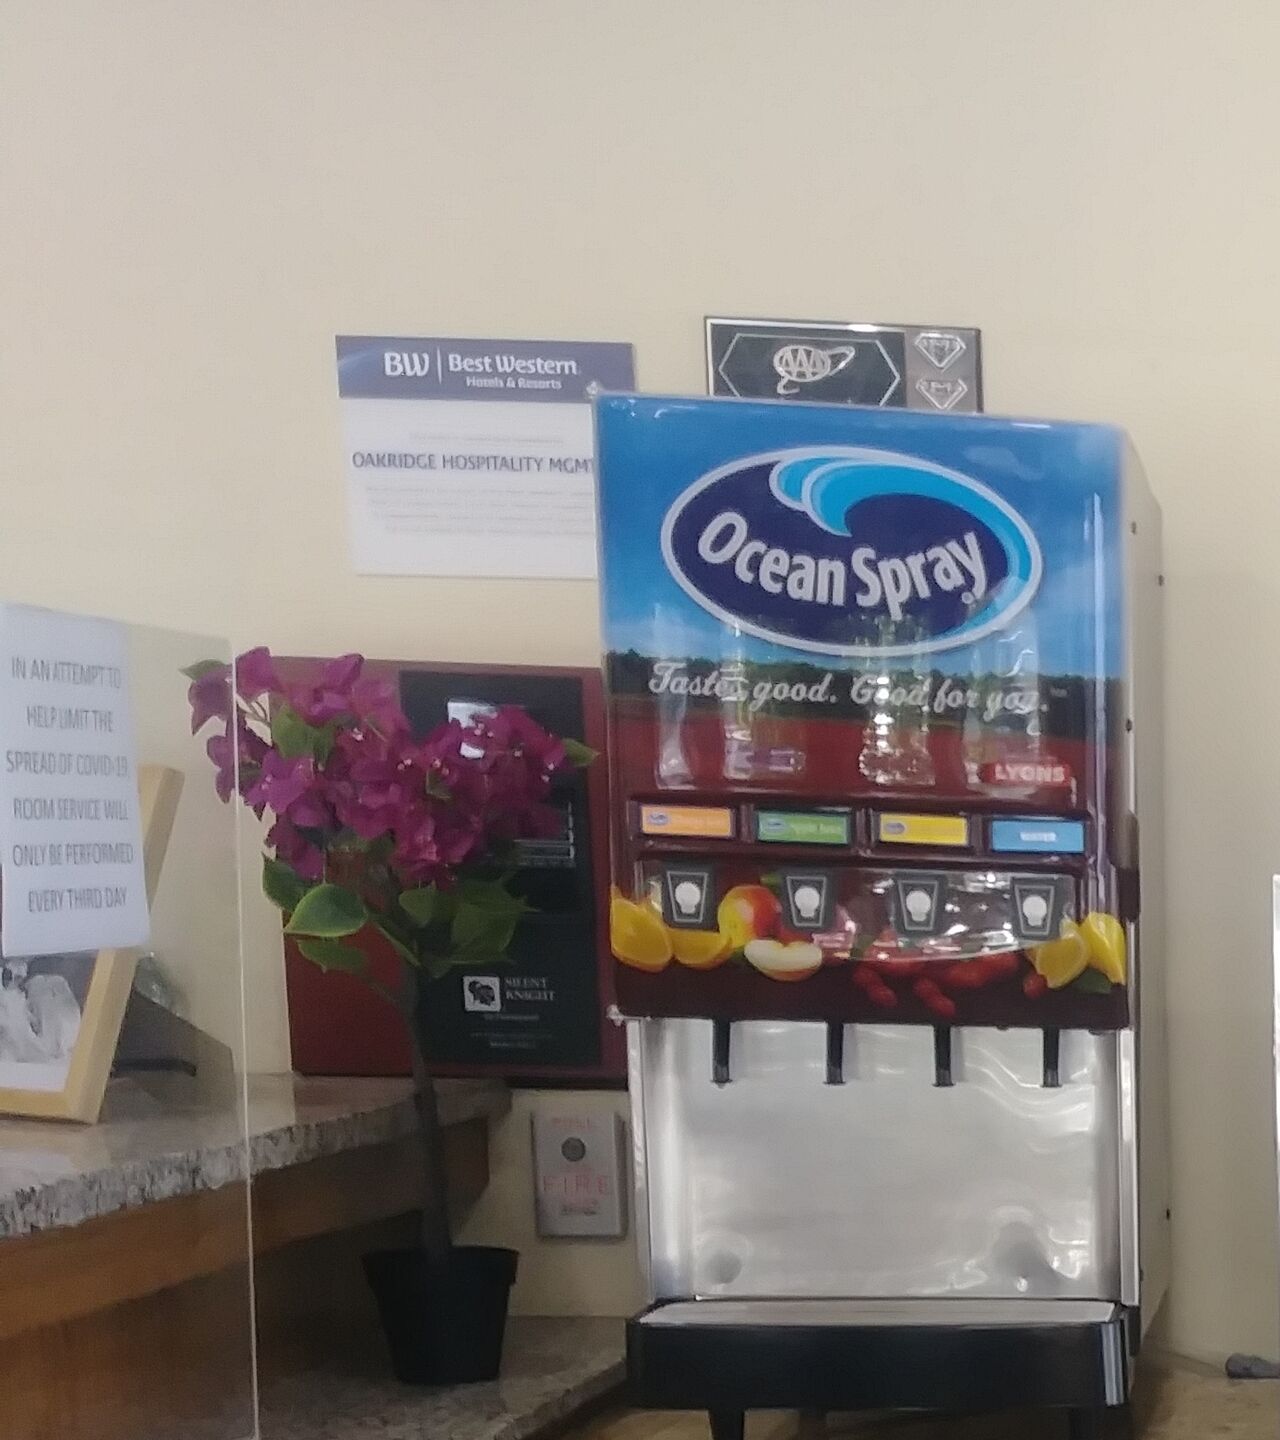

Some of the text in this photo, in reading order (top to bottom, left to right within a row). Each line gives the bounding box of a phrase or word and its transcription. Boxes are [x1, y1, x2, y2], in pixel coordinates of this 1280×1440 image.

[383, 351, 578, 377] BW Best Western
[465, 376, 562, 390] Hotels & Resorts
[352, 452, 435, 469] OAKRIDGE
[442, 453, 544, 472] HOSPITALITY
[697, 511, 987, 621] Ocean Spray
[11, 657, 121, 689] IN AN ATTEMPT TO
[752, 672, 837, 712] good.
[933, 678, 979, 713] for
[26, 705, 113, 732] HELP LIMIT THE
[6, 750, 57, 775] SPREAD
[59, 752, 73, 775] OF
[994, 763, 1065, 782] LYONS
[13, 798, 129, 820] ROOM SERVICE WILL
[12, 842, 134, 867] ONLY BE PERFORMED
[28, 886, 127, 913] EVERY THIRD DAY
